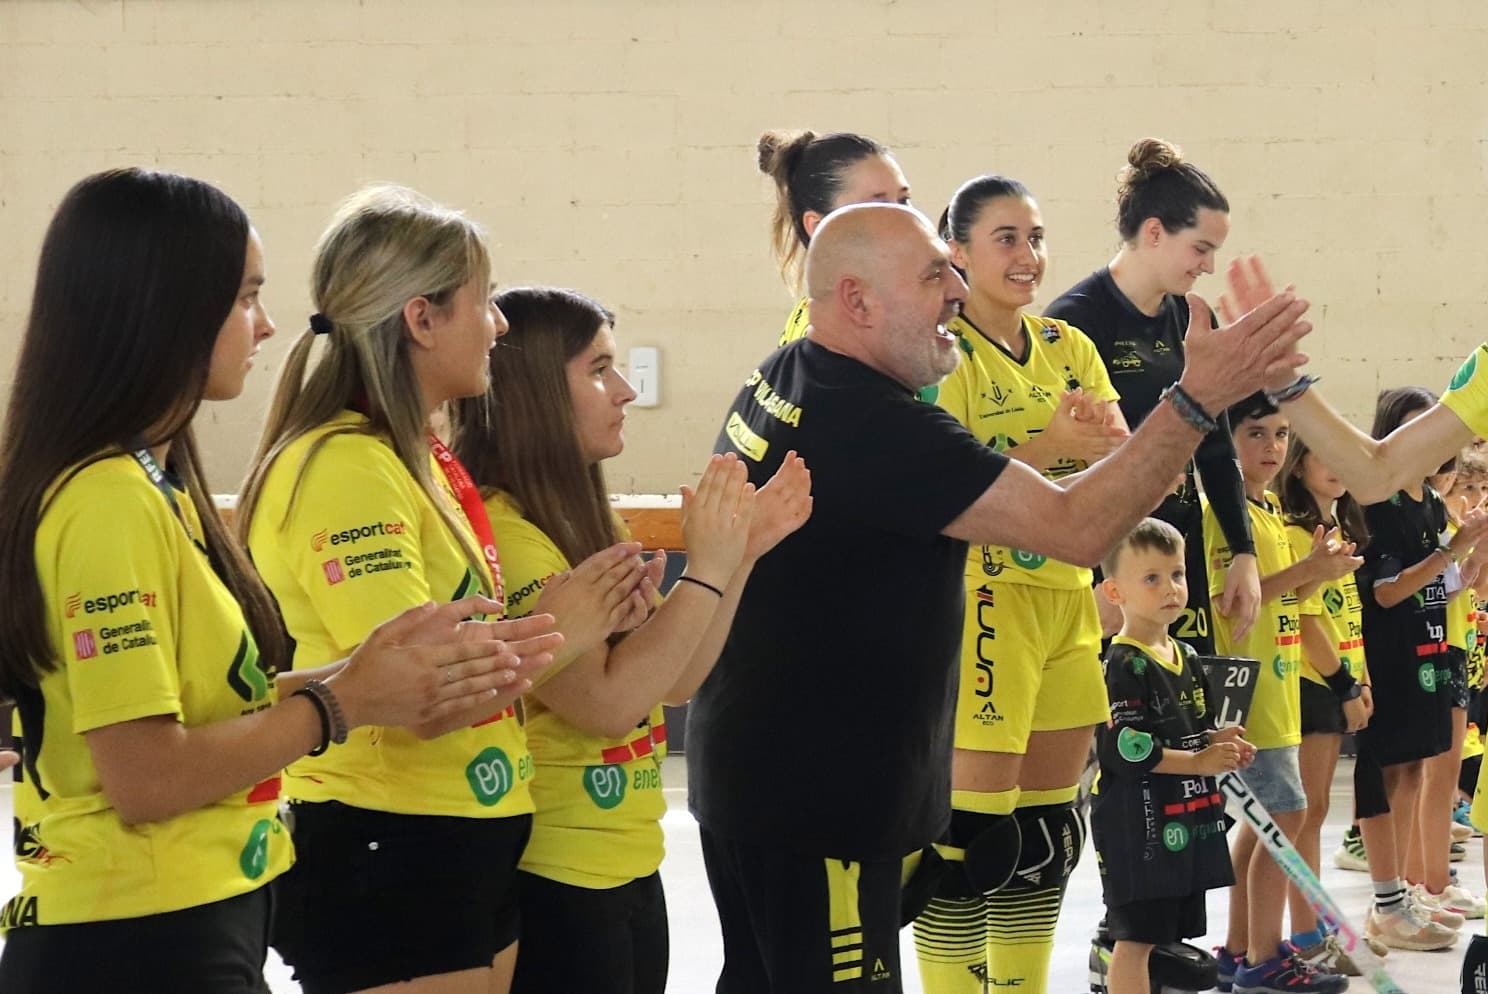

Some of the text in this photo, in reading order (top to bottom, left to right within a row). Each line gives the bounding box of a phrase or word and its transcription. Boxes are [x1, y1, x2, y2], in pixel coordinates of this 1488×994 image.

[348, 567, 363, 579] de
[1177, 607, 1208, 638] 20
[103, 641, 119, 654] de
[1223, 666, 1250, 687] 20
[973, 713, 1004, 722] ALTAN
